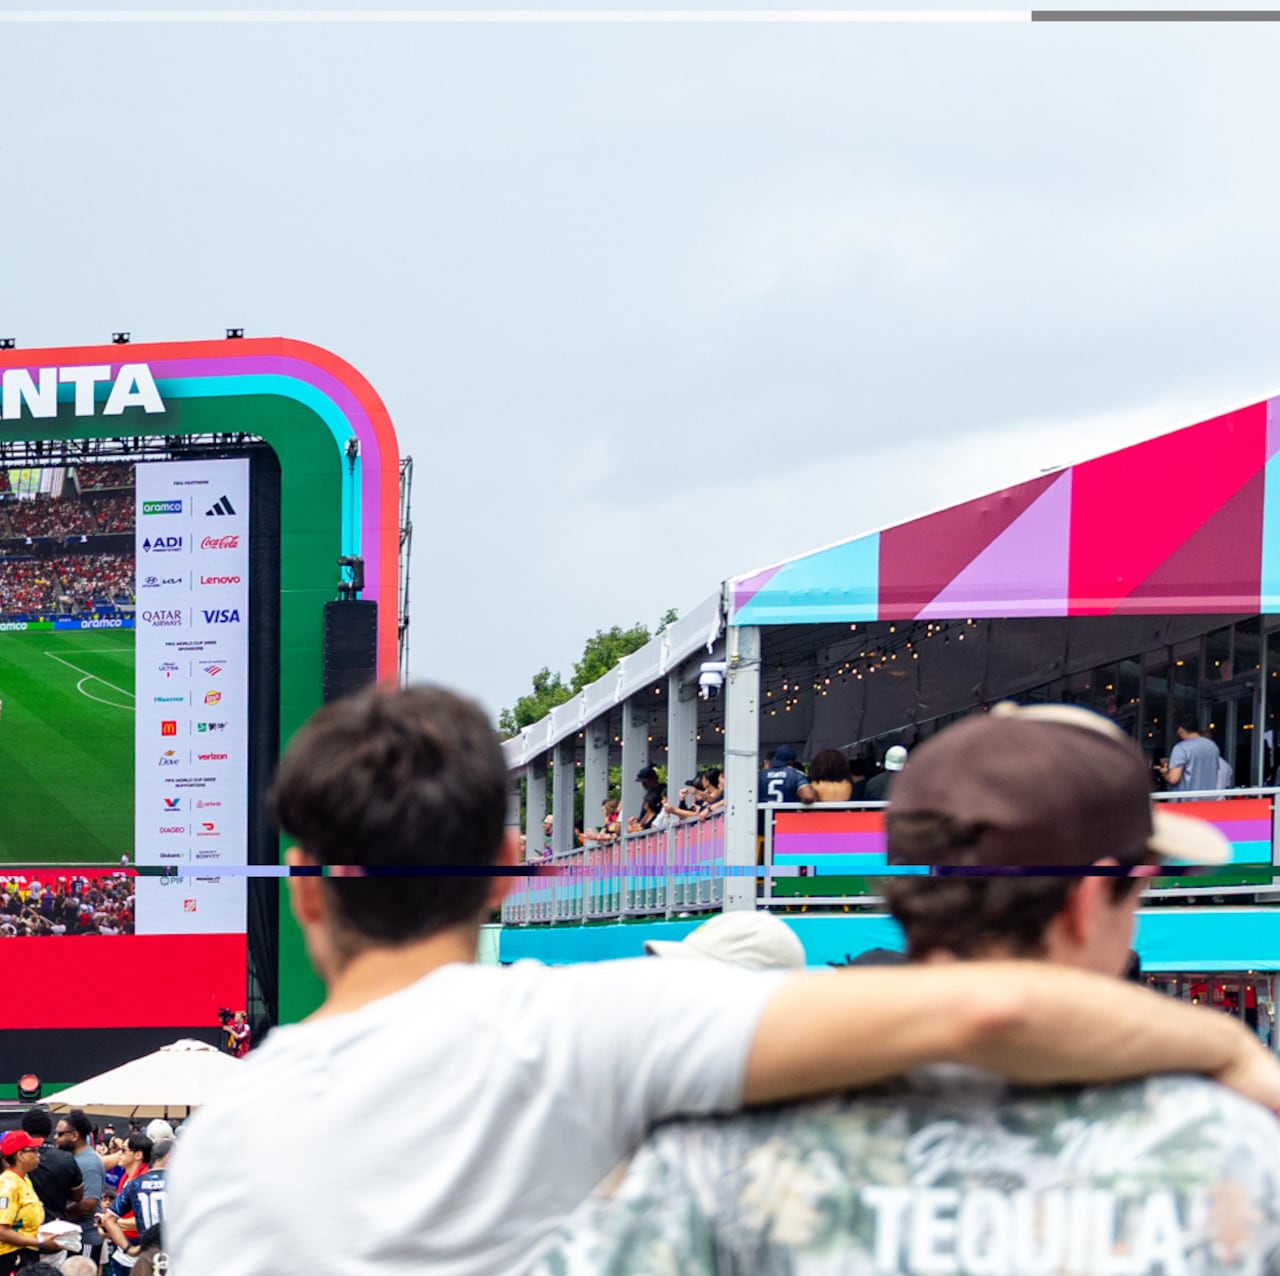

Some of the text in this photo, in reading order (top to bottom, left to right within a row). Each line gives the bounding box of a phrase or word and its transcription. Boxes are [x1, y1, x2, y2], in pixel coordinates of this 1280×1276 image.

[143, 502, 182, 513] aramco
[153, 536, 182, 548] ADI
[200, 575, 241, 585] Lenovo
[142, 609, 182, 623] QATAR
[201, 609, 240, 624] VISA
[81, 619, 123, 629] aramco
[198, 752, 227, 761] verizon
